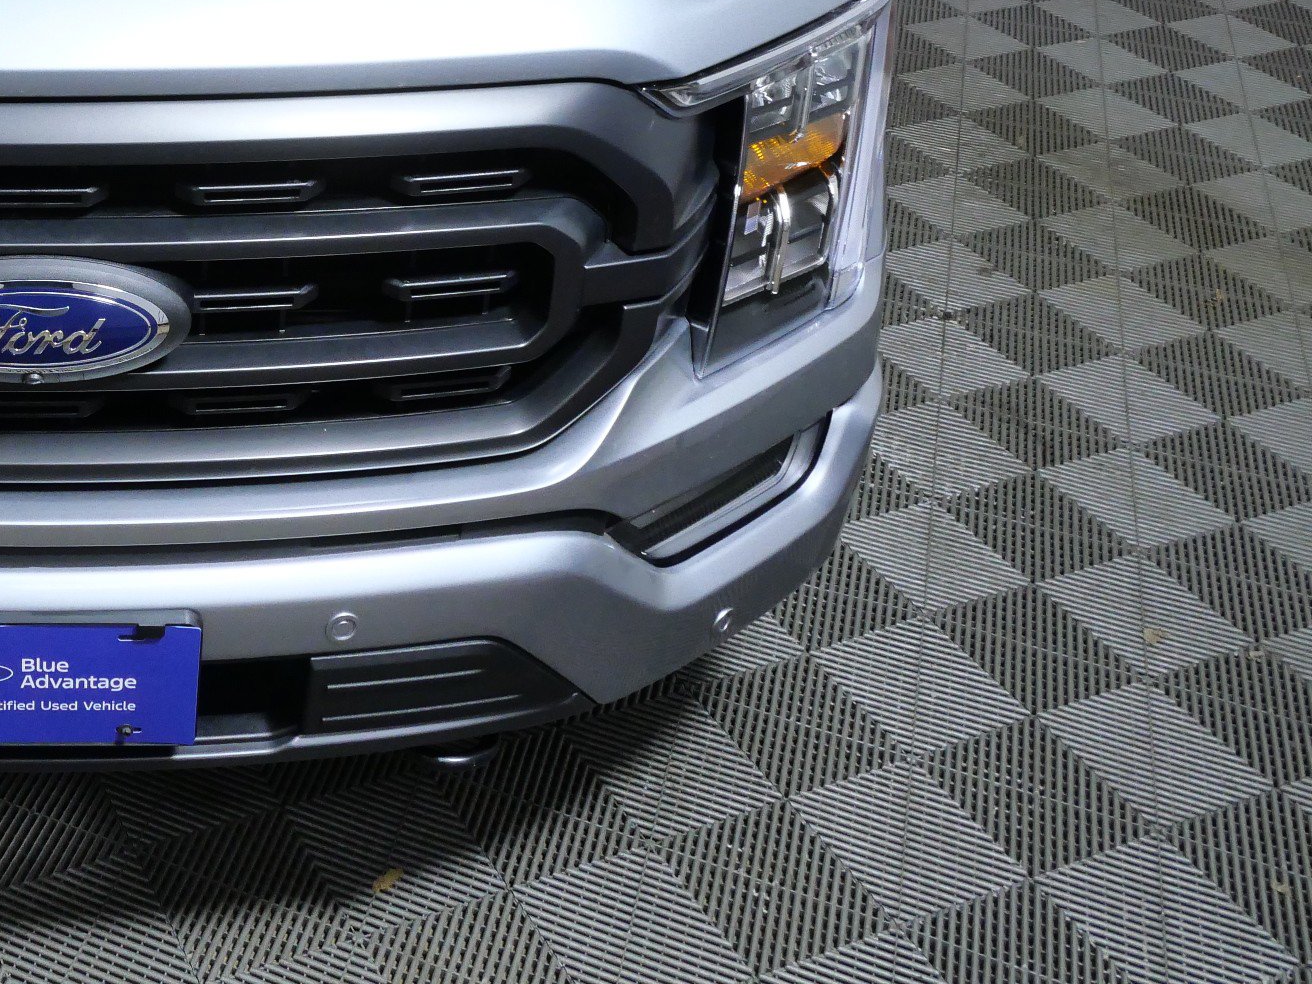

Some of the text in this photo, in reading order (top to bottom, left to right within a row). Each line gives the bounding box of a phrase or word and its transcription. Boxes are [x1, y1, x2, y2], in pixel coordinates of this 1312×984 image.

[21, 658, 69, 673] Blue
[20, 675, 137, 691] Advantage
[41, 701, 78, 711] Used
[84, 701, 137, 711] Vehicle
